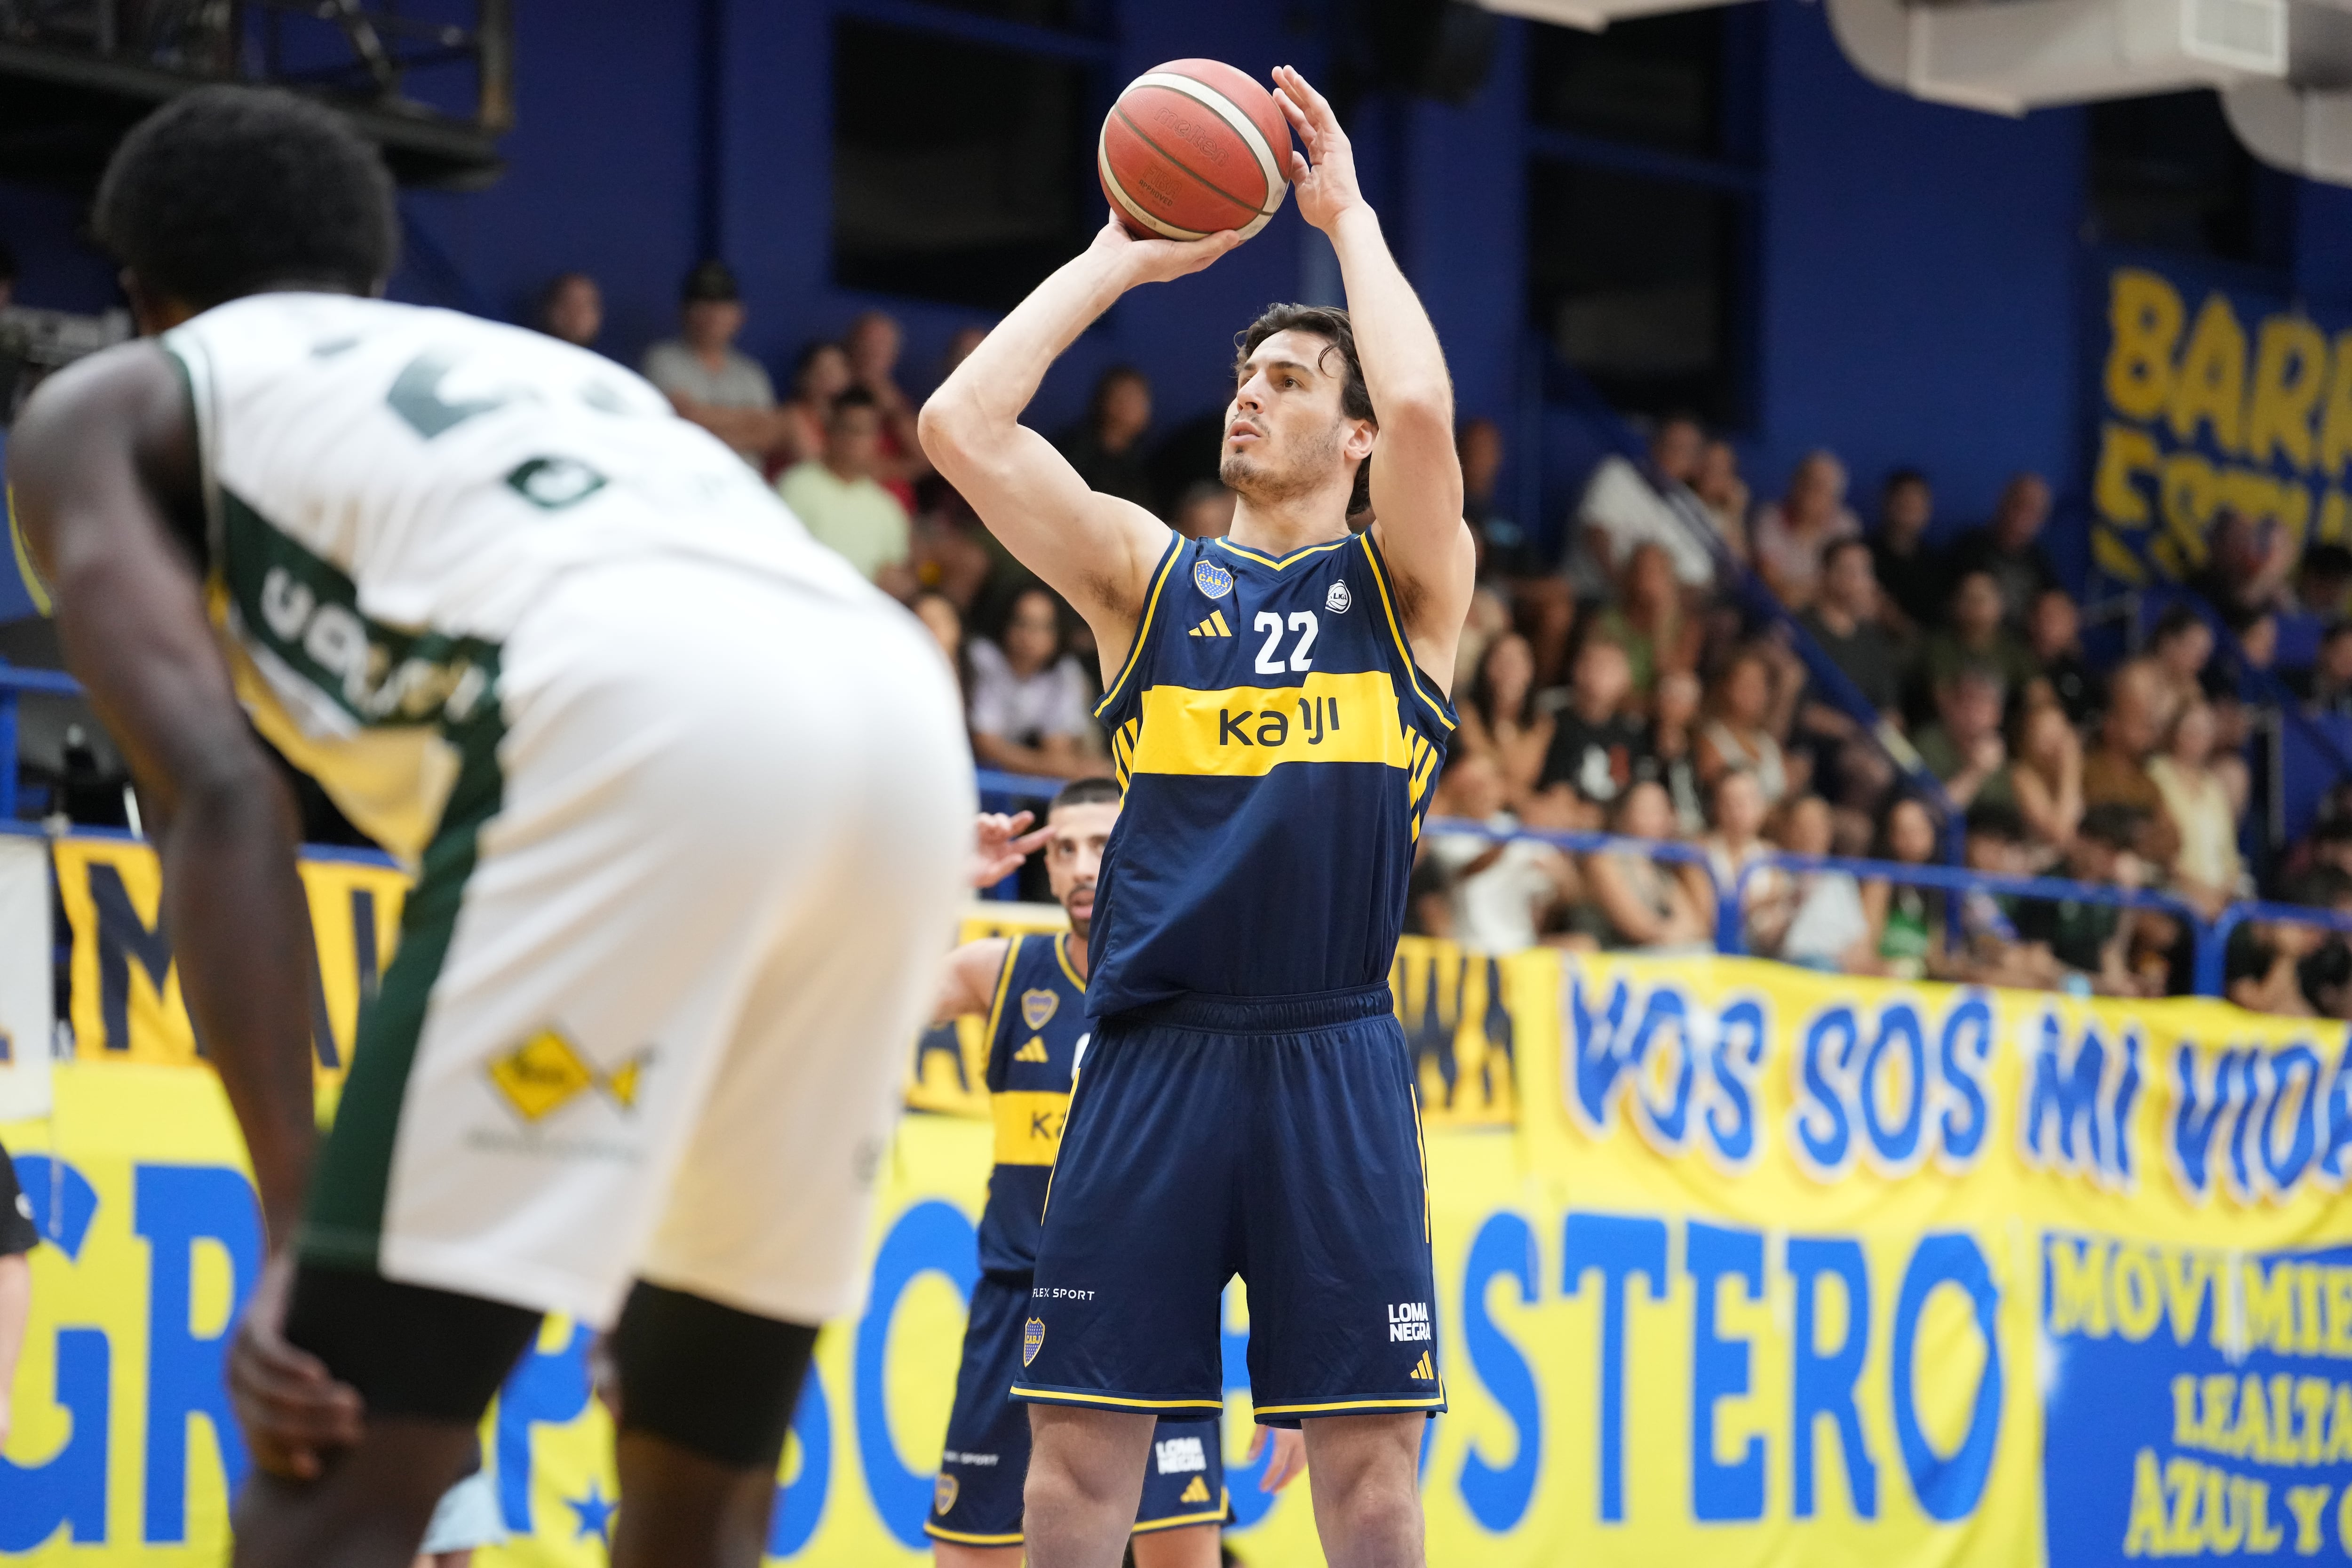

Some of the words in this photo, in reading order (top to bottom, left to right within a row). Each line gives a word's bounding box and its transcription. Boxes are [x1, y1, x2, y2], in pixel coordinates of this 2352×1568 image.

[1154, 107, 1229, 167] molten
[1139, 179, 1173, 207] APPROVED
[1199, 573, 1228, 588] CABJ
[1333, 592, 1347, 601] LIGA
[1254, 610, 1319, 675] 22
[1564, 960, 1766, 1161] VOS
[1799, 990, 1991, 1168] SOS
[2028, 1008, 2140, 1182] MI
[1052, 1288, 1095, 1301] SPORT
[1388, 1302, 1429, 1323] LOMA
[1026, 1335, 1041, 1344] CABJ
[1390, 1322, 1431, 1342] NEGRA
[1420, 1210, 2002, 1535] STERO
[2123, 1446, 2284, 1558] AZUL
[2285, 1484, 2331, 1557] Y
